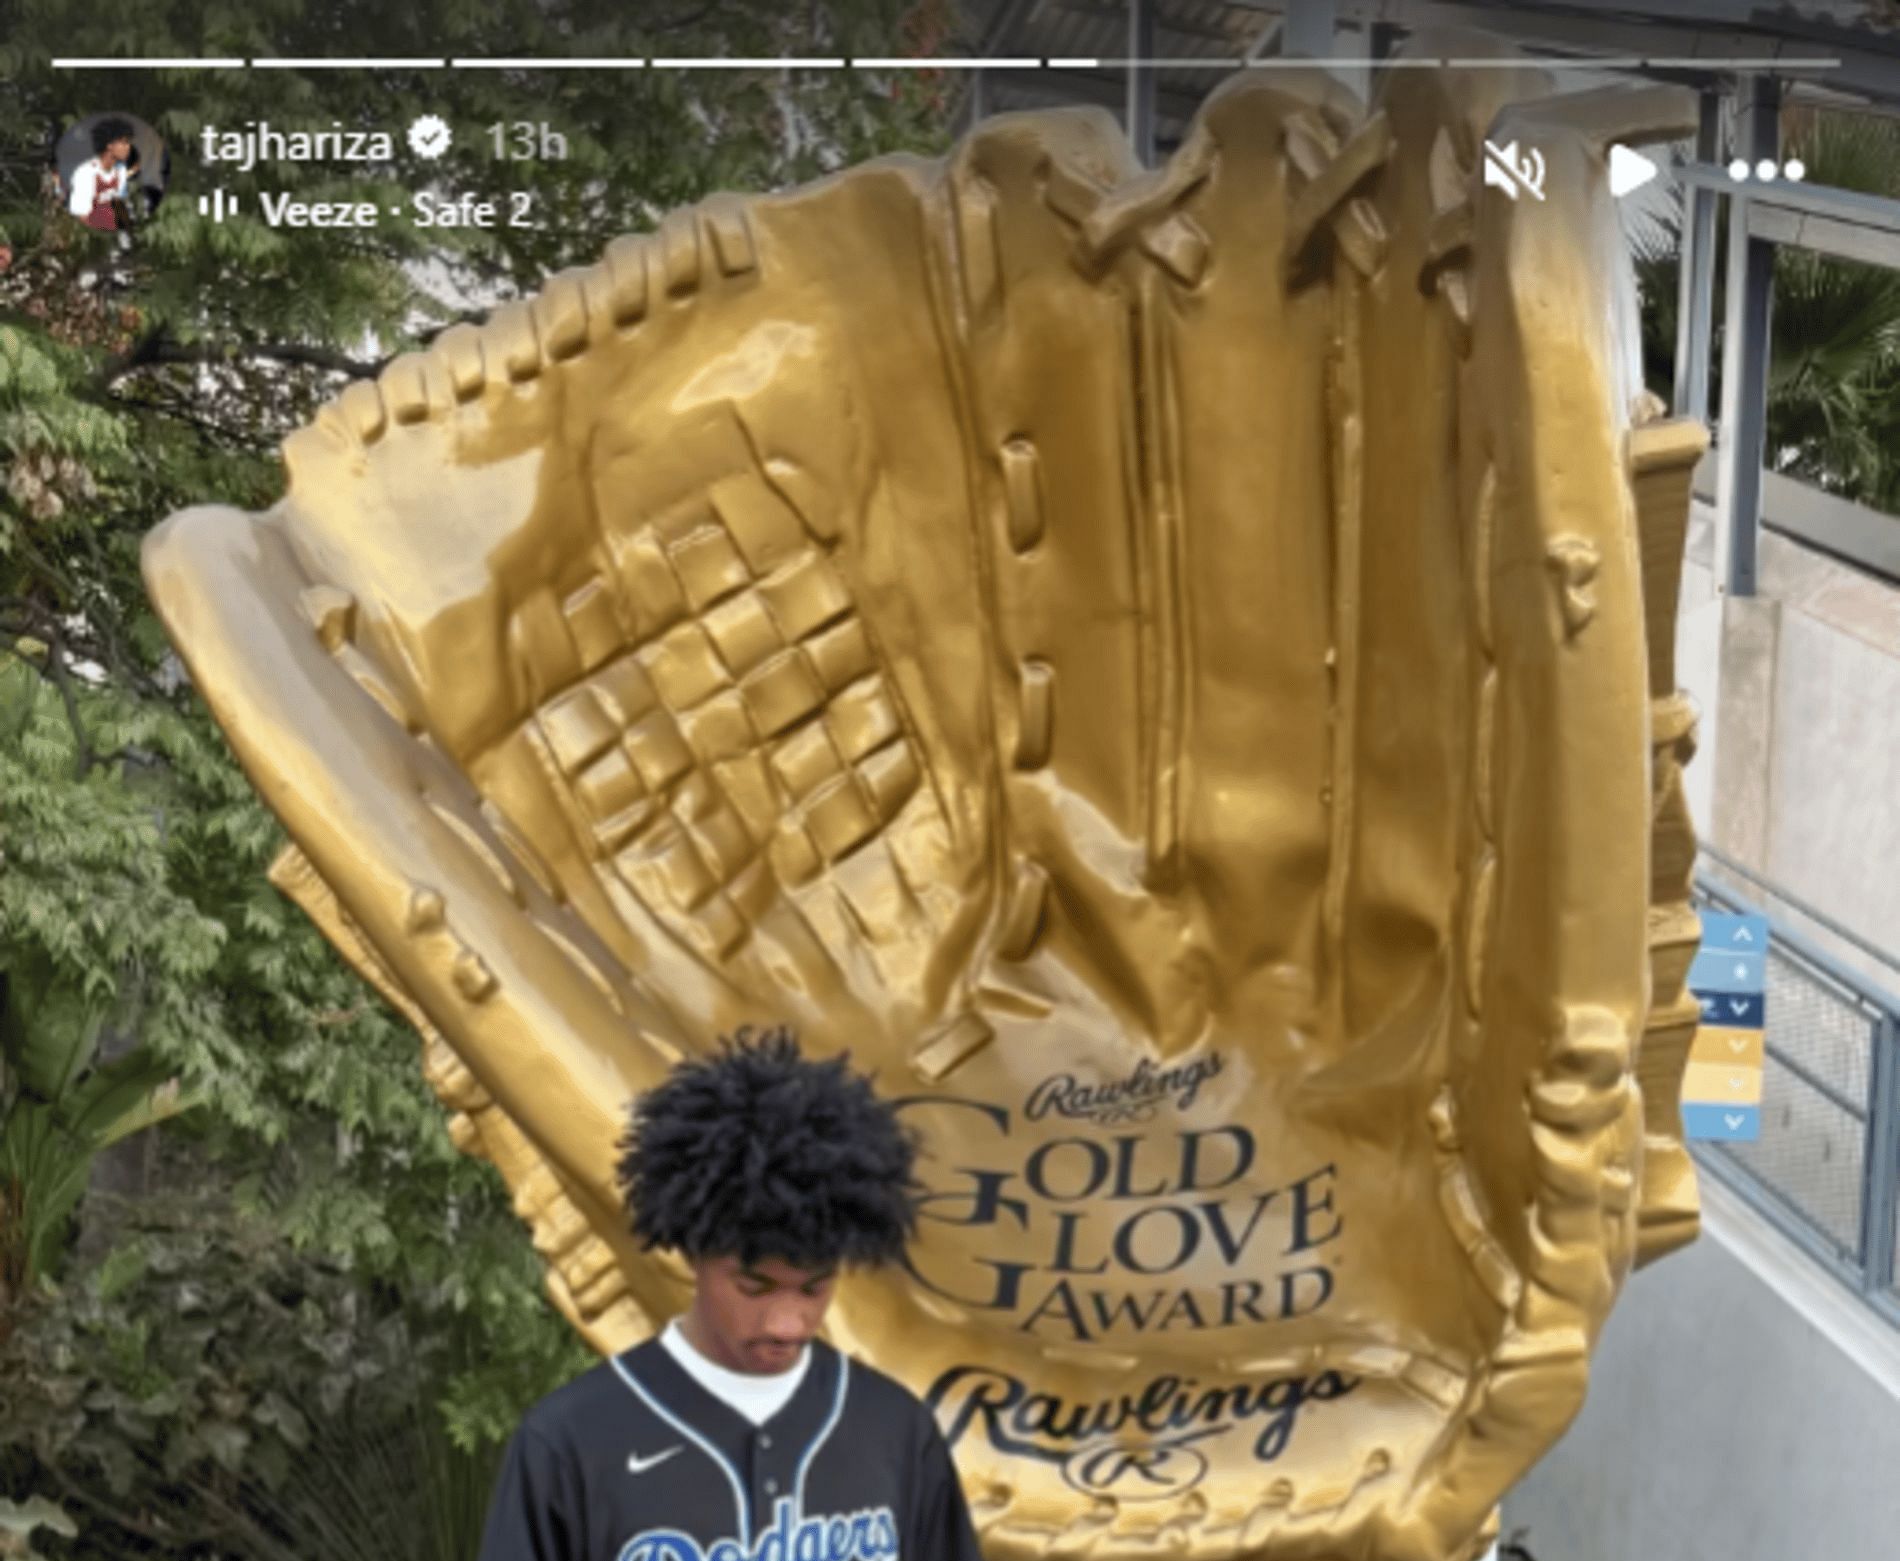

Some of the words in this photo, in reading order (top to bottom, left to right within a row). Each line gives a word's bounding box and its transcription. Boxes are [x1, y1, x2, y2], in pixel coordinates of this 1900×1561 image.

[1023, 1051, 1226, 1122] Rawlings
[893, 1094, 1256, 1226] GOLD
[903, 1163, 1343, 1311] GLOVE
[1016, 1265, 1336, 1342] AWARD
[925, 1364, 1363, 1463] Rawlings
